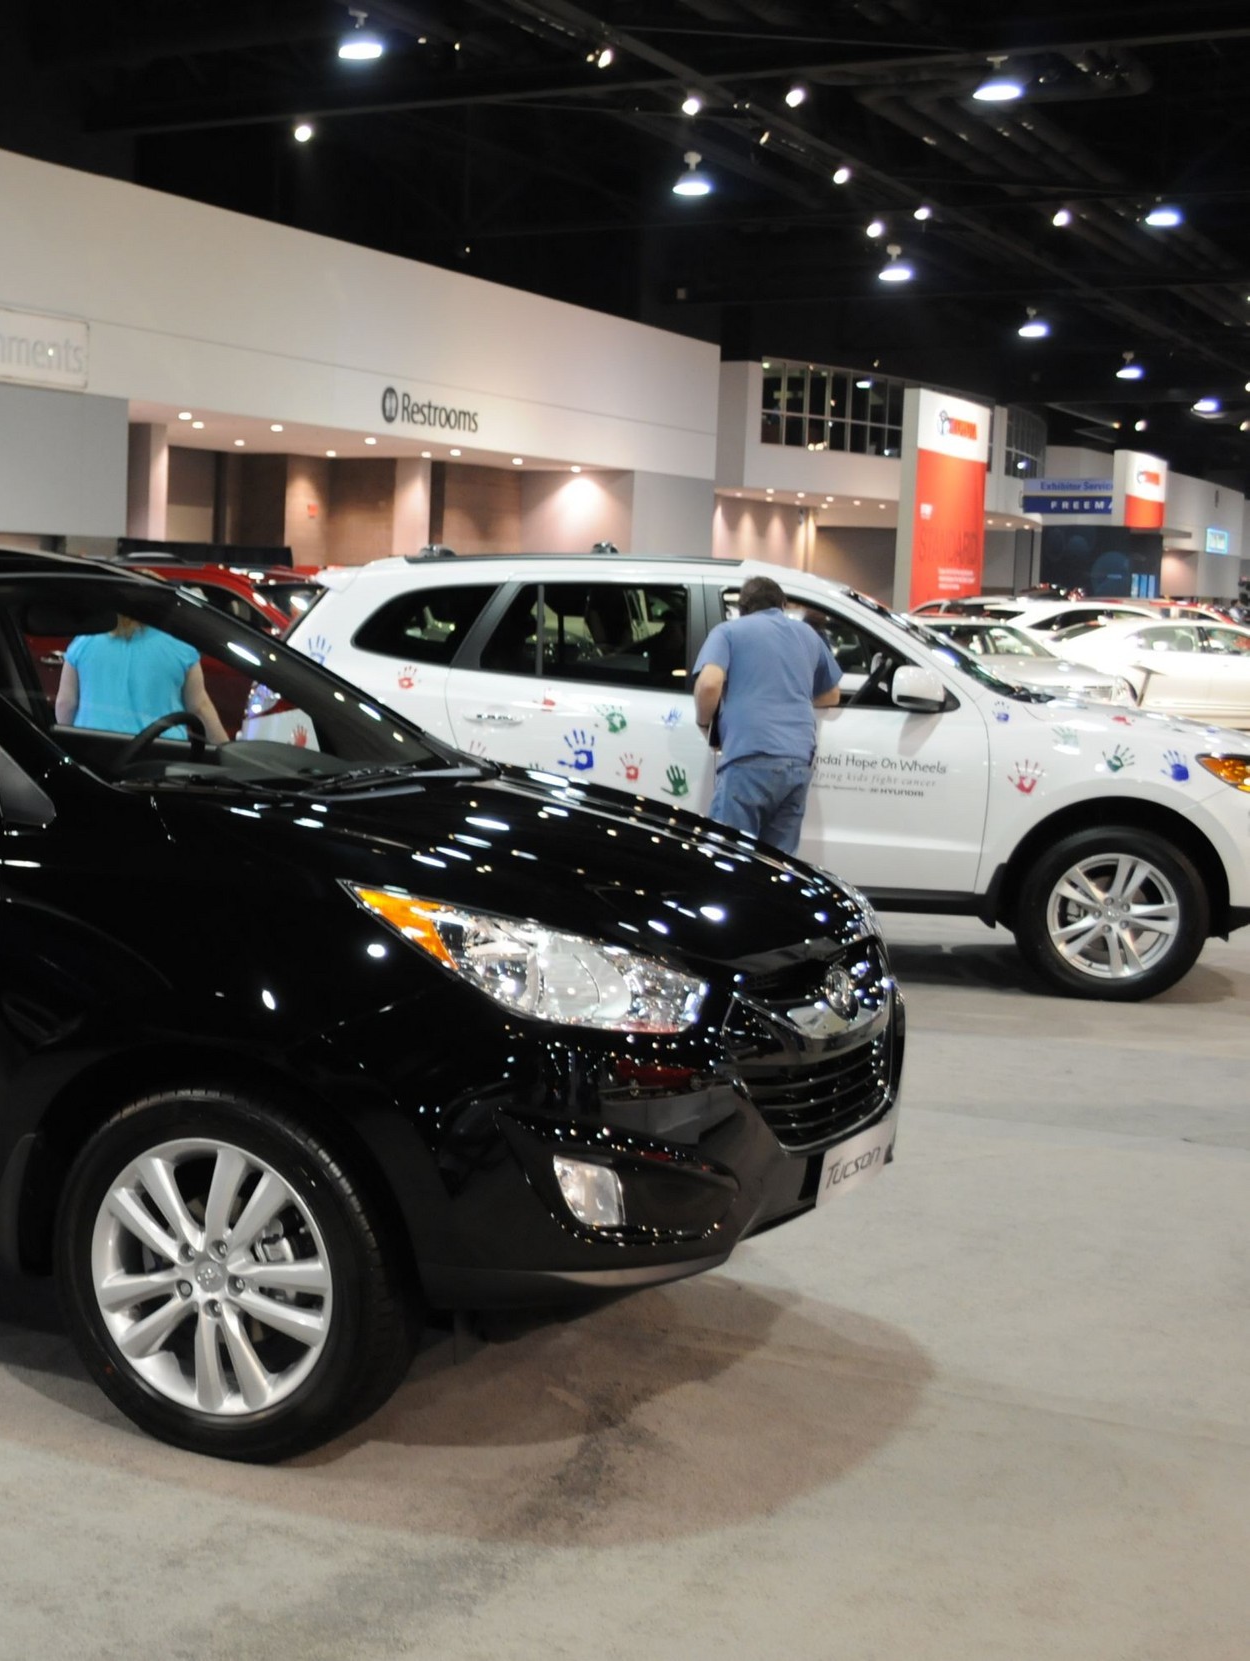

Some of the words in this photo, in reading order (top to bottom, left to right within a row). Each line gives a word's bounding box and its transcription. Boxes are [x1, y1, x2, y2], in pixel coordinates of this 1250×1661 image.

[401, 392, 479, 433] Restrooms
[1040, 481, 1081, 491] Exhibitor
[815, 754, 842, 767] ndai
[845, 754, 878, 771] Hope
[881, 758, 897, 770] On
[900, 759, 947, 774] Wheels
[815, 770, 843, 783] lping
[826, 1146, 881, 1190] Tucson
